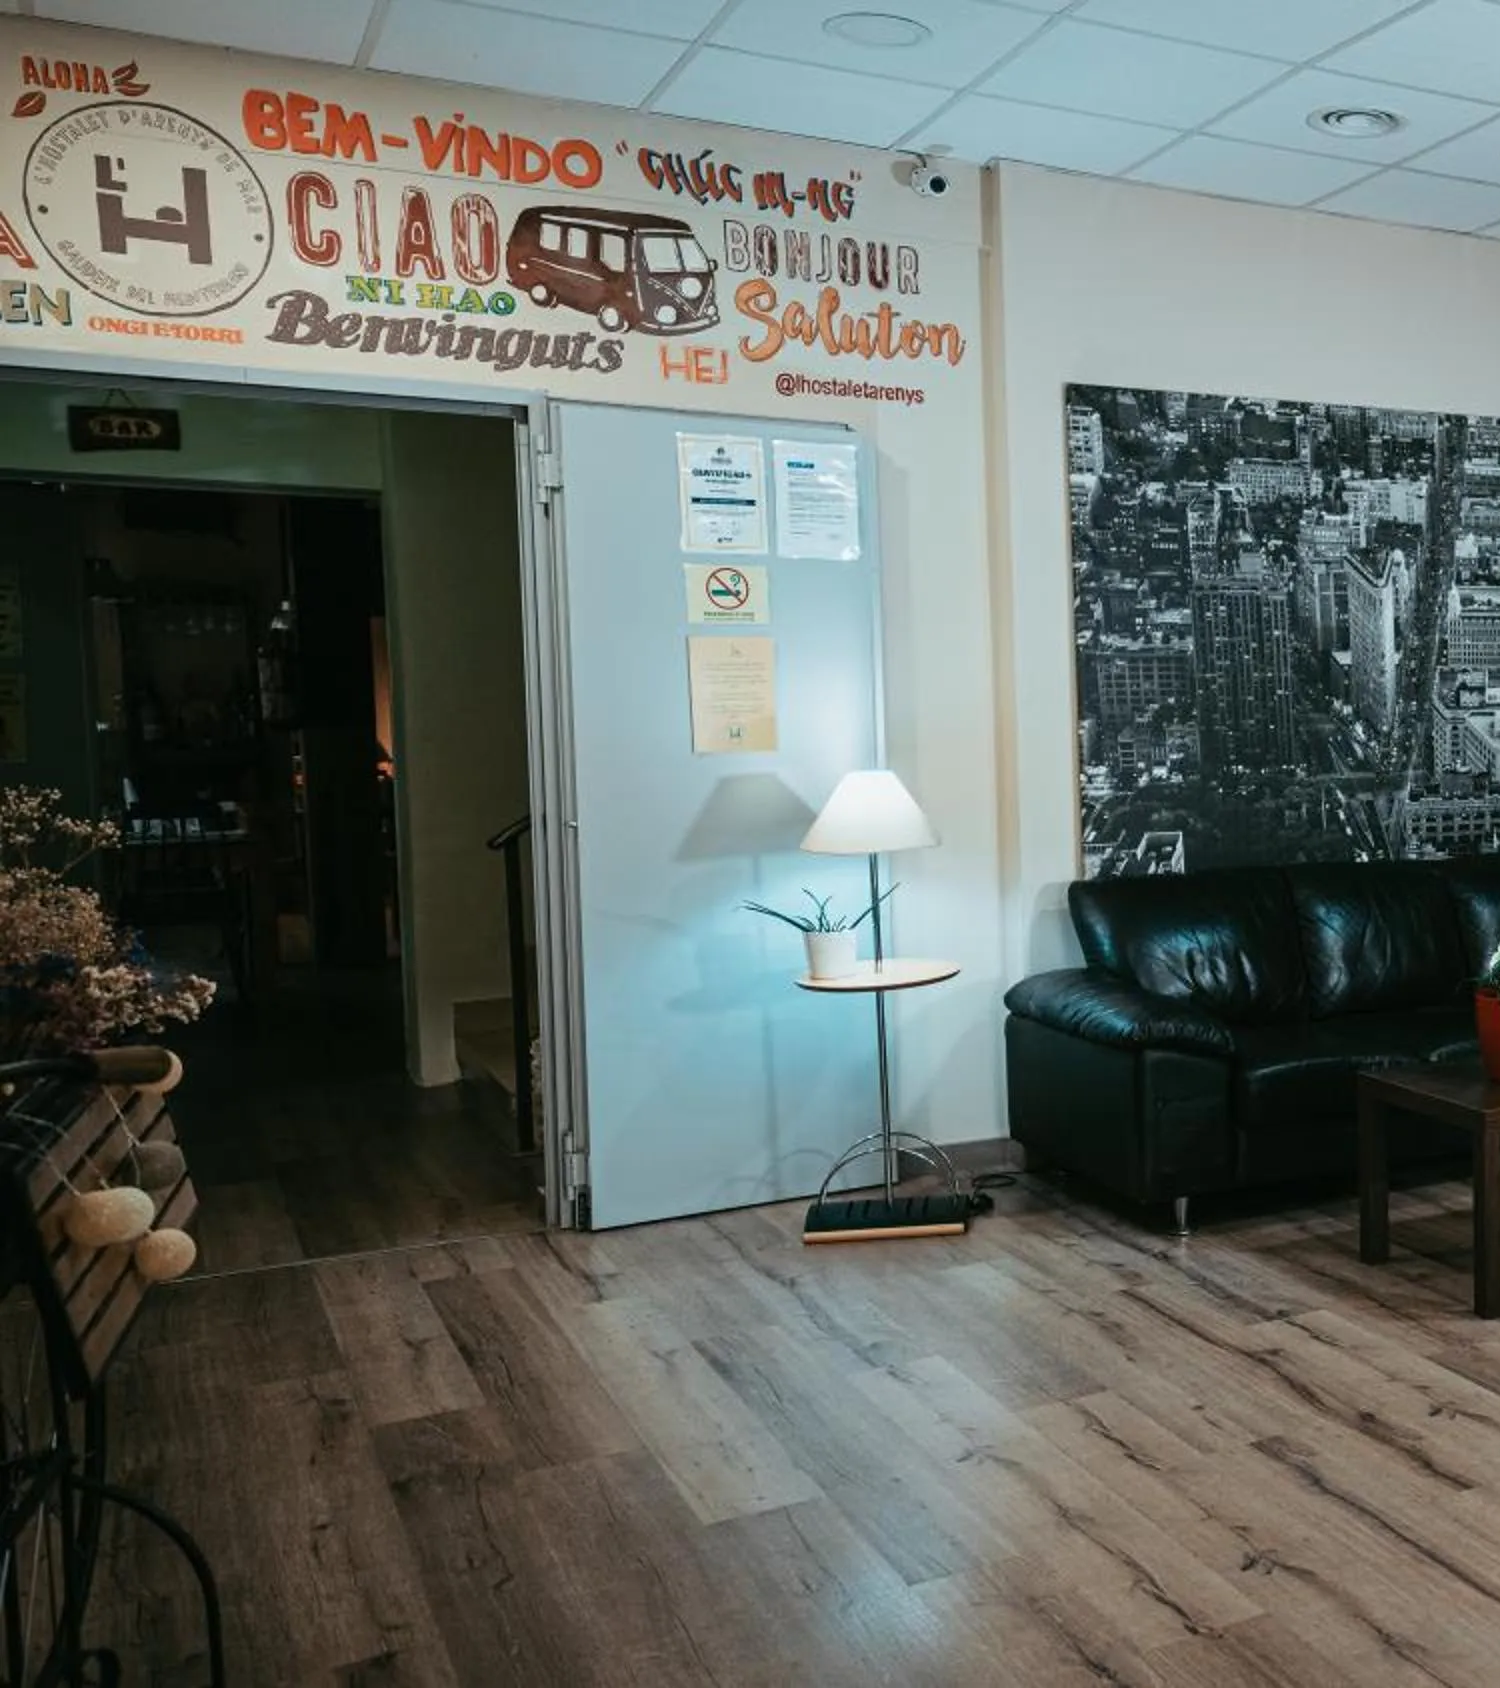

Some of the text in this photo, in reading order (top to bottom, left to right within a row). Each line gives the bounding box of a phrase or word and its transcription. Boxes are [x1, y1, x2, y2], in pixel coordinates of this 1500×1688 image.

[21, 56, 110, 94] ALOHA
[286, 170, 500, 286] CIAO
[723, 219, 920, 295] BONJOUR
[265, 289, 625, 374] Benvinguts
[345, 275, 517, 317] NI HAO
[734, 277, 966, 367] Saluton
[775, 373, 924, 406] @lhostaletarenys
